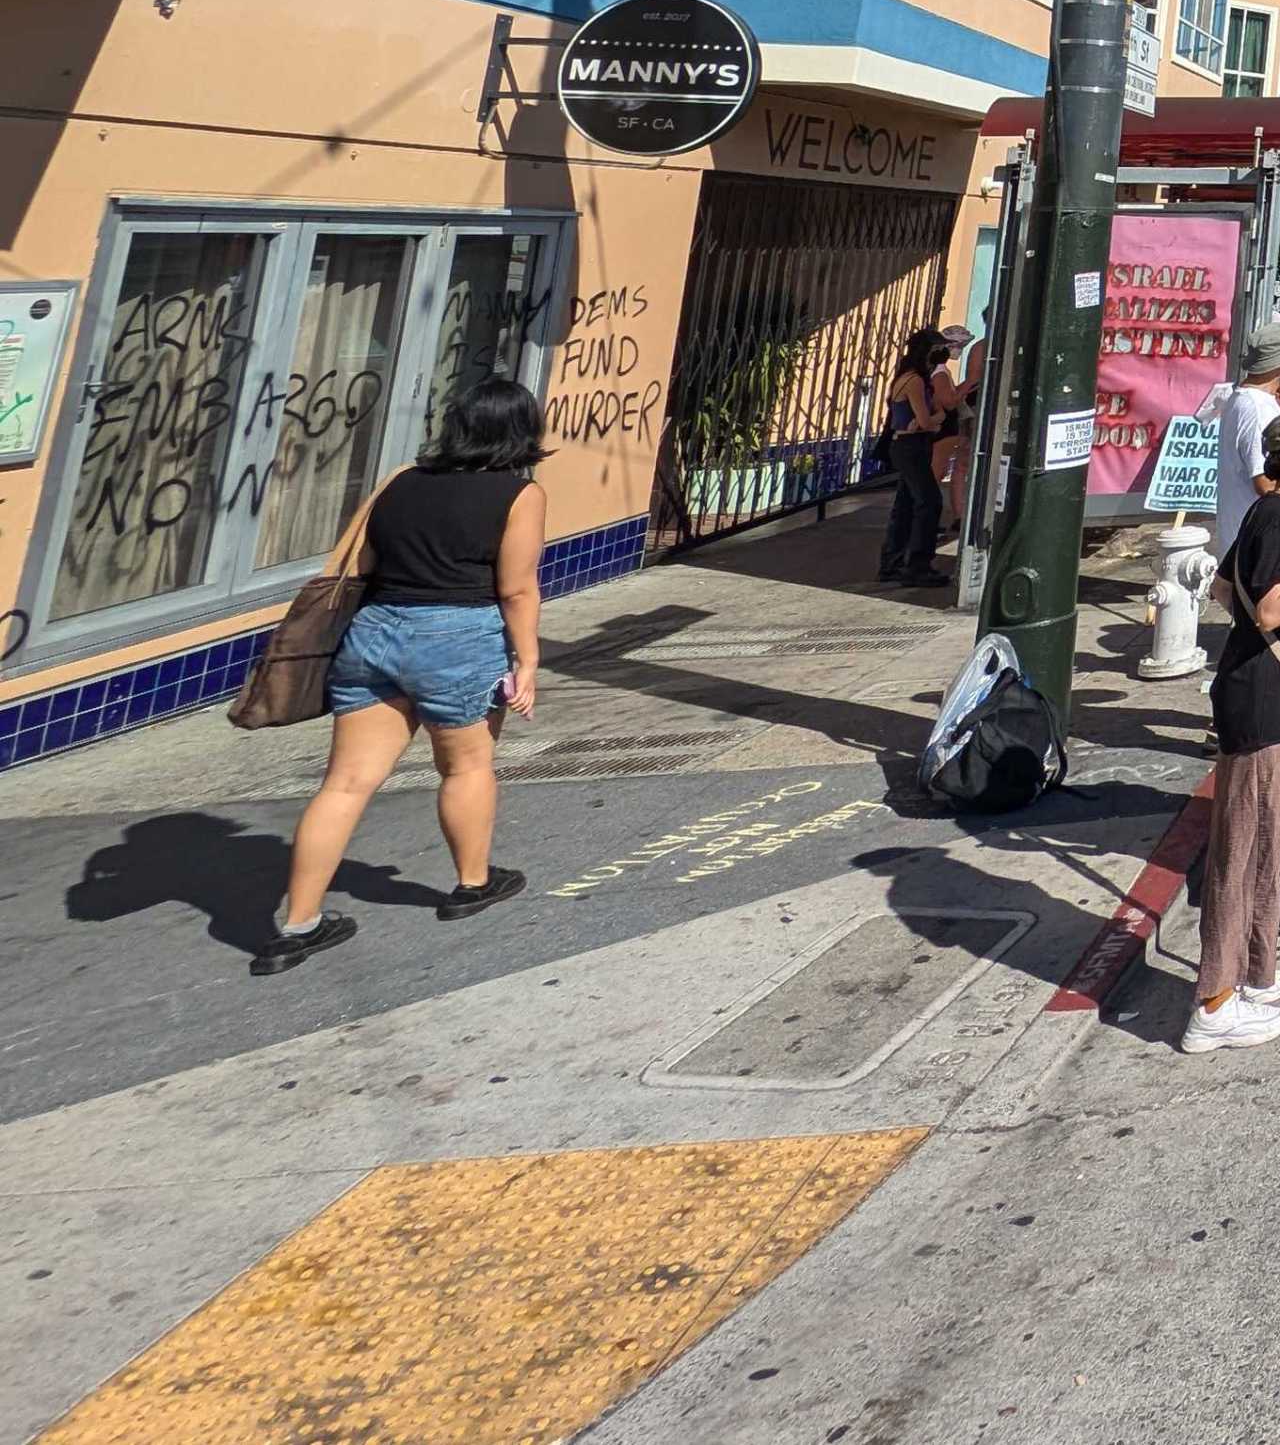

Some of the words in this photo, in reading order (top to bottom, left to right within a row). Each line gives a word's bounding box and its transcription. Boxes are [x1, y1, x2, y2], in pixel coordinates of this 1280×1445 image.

[568, 58, 740, 87] MANNY'S
[617, 117, 640, 128] SF
[652, 118, 675, 130] CA
[764, 108, 936, 181] WELCOME
[114, 292, 252, 352] ARMS
[570, 285, 648, 328] DEMS
[560, 333, 640, 384] FUND
[544, 380, 662, 446] MURDER
[1171, 421, 1198, 439] NO
[1160, 465, 1201, 484] WAR
